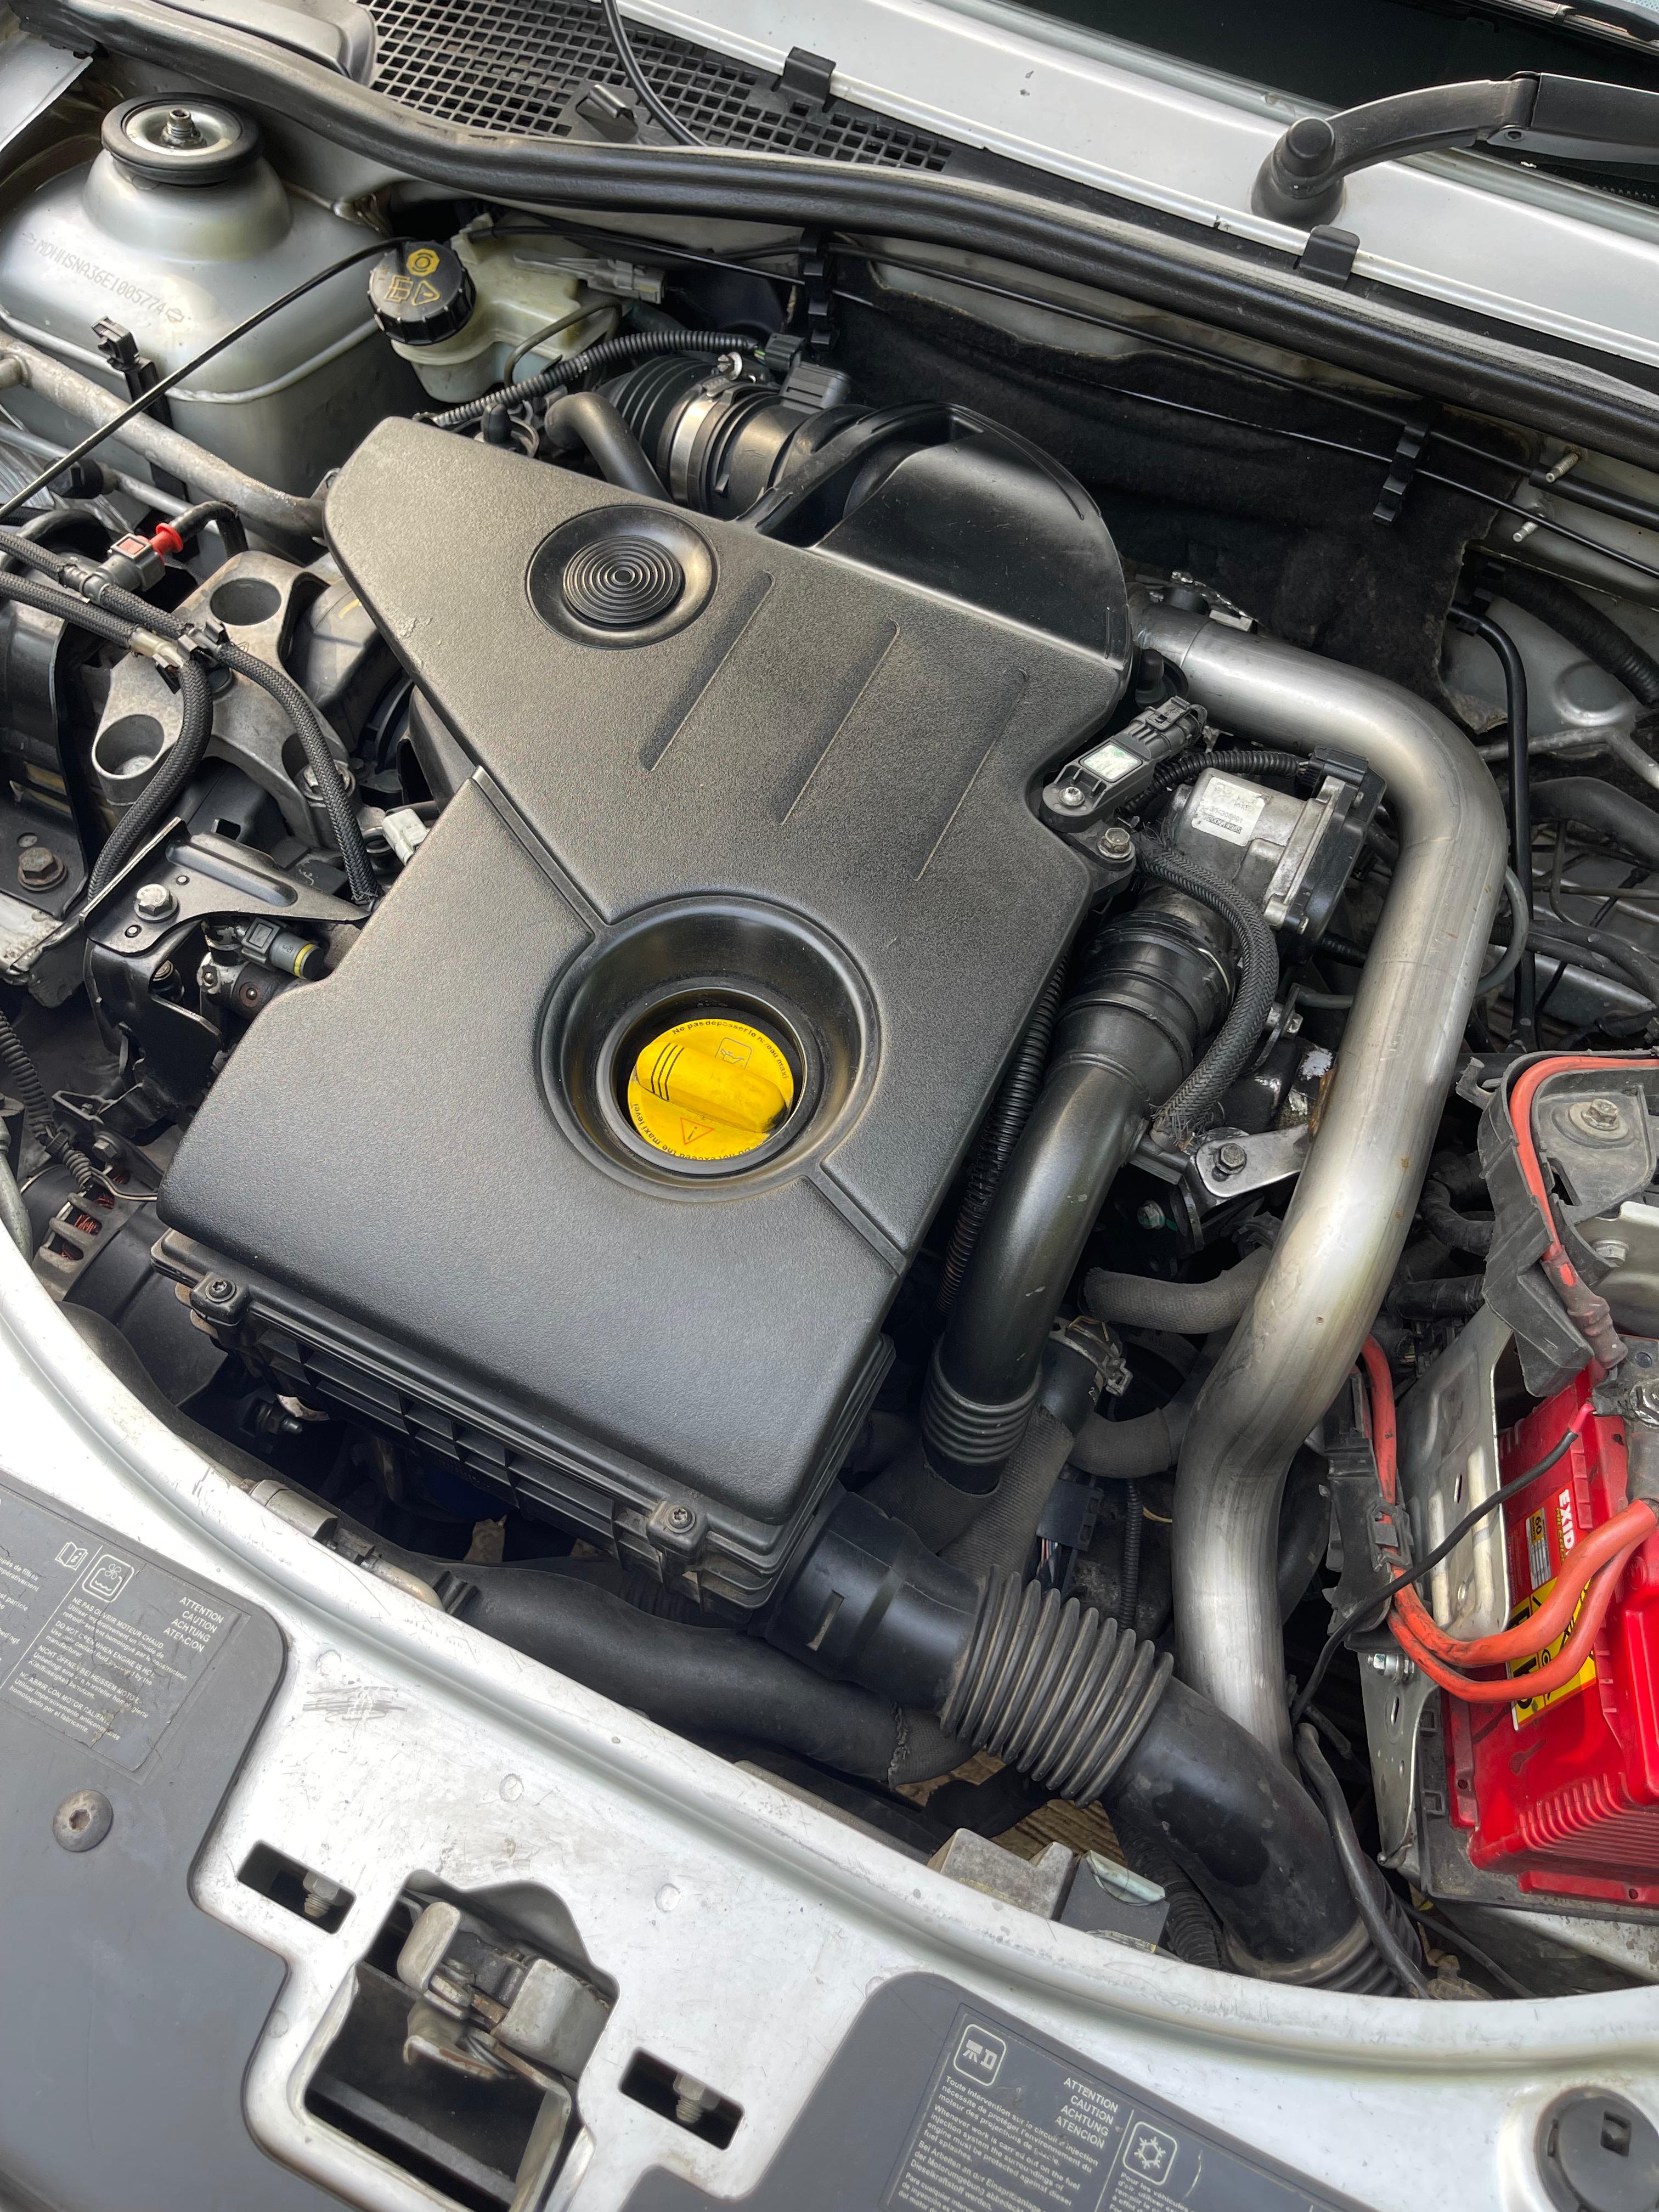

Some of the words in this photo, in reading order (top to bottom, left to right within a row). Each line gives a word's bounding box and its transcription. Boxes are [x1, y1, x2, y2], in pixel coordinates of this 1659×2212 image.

[672, 1025, 685, 1035] Ne
[687, 1020, 704, 1031] pas
[633, 1103, 644, 1130] level
[642, 1126, 661, 1147] maxi
[1534, 1516, 1542, 1535] 60
[1559, 1488, 1576, 1555] EXID
[72, 1596, 82, 1605] NE
[81, 1601, 94, 1612] PAS
[116, 1620, 142, 1637] MOTEUR
[142, 1634, 163, 1650] CHAUD.
[179, 1596, 224, 1623] ATTENTION
[182, 1610, 218, 1633] CAUTION
[55, 1620, 65, 1629] DO
[64, 1625, 79, 1635] NOT
[95, 1641, 114, 1655] WHEN
[112, 1651, 136, 1667] ENGINE
[163, 1627, 205, 1652] ATENCION
[171, 1618, 211, 1642] ACHTUNG
[33, 1651, 62, 1671] Unbedingt
[37, 1644, 58, 1658] NICHT
[79, 1667, 92, 1677] BEI
[90, 1673, 117, 1691] HEISSEM
[50, 1627, 62, 1637] Use
[95, 1651, 110, 1662] fluid
[134, 1672, 143, 1681] by
[8, 1684, 43, 1707] homologado
[27, 1677, 48, 1690] ABRIR
[47, 1687, 61, 1698] CON
[60, 1694, 83, 1710] MOTOR
[946, 2075, 966, 2092] Toute
[967, 2087, 1011, 2117] intervention
[1011, 2114, 1024, 2124] sur
[1063, 2077, 1118, 2113] ATTENTION
[1070, 2095, 1114, 2125] CAUTION
[923, 2129, 938, 2142] fuel
[930, 2112, 961, 2134] injection
[962, 2131, 989, 2150] system
[990, 2146, 1002, 2157] the
[938, 2094, 964, 2111] moteur
[965, 2109, 979, 2120] des
[1023, 2141, 1032, 2149] de
[941, 2085, 976, 2108] nécessite
[977, 2105, 987, 2114] de
[988, 2111, 1019, 2132] protéger
[1081, 2163, 1092, 2173] du
[1056, 2115, 1105, 2149] ATENCION
[1060, 2104, 1109, 2136] ACHTUNG
[914, 2151, 927, 2162] der
[918, 2140, 930, 2152] Bei
[930, 2148, 961, 2169] Arbeiten
[962, 2166, 971, 2175] an
[927, 2121, 951, 2139] engine
[972, 2146, 982, 2156] be
[1019, 2174, 1048, 2193] against
[934, 2103, 970, 2128] Whenever
[971, 2125, 989, 2140] work
[1040, 2164, 1050, 2174] on
[1051, 2170, 1064, 2181] the
[1065, 2177, 1080, 2190] fuel
[901, 2182, 910, 2190] de
[905, 2171, 920, 2186] Para
